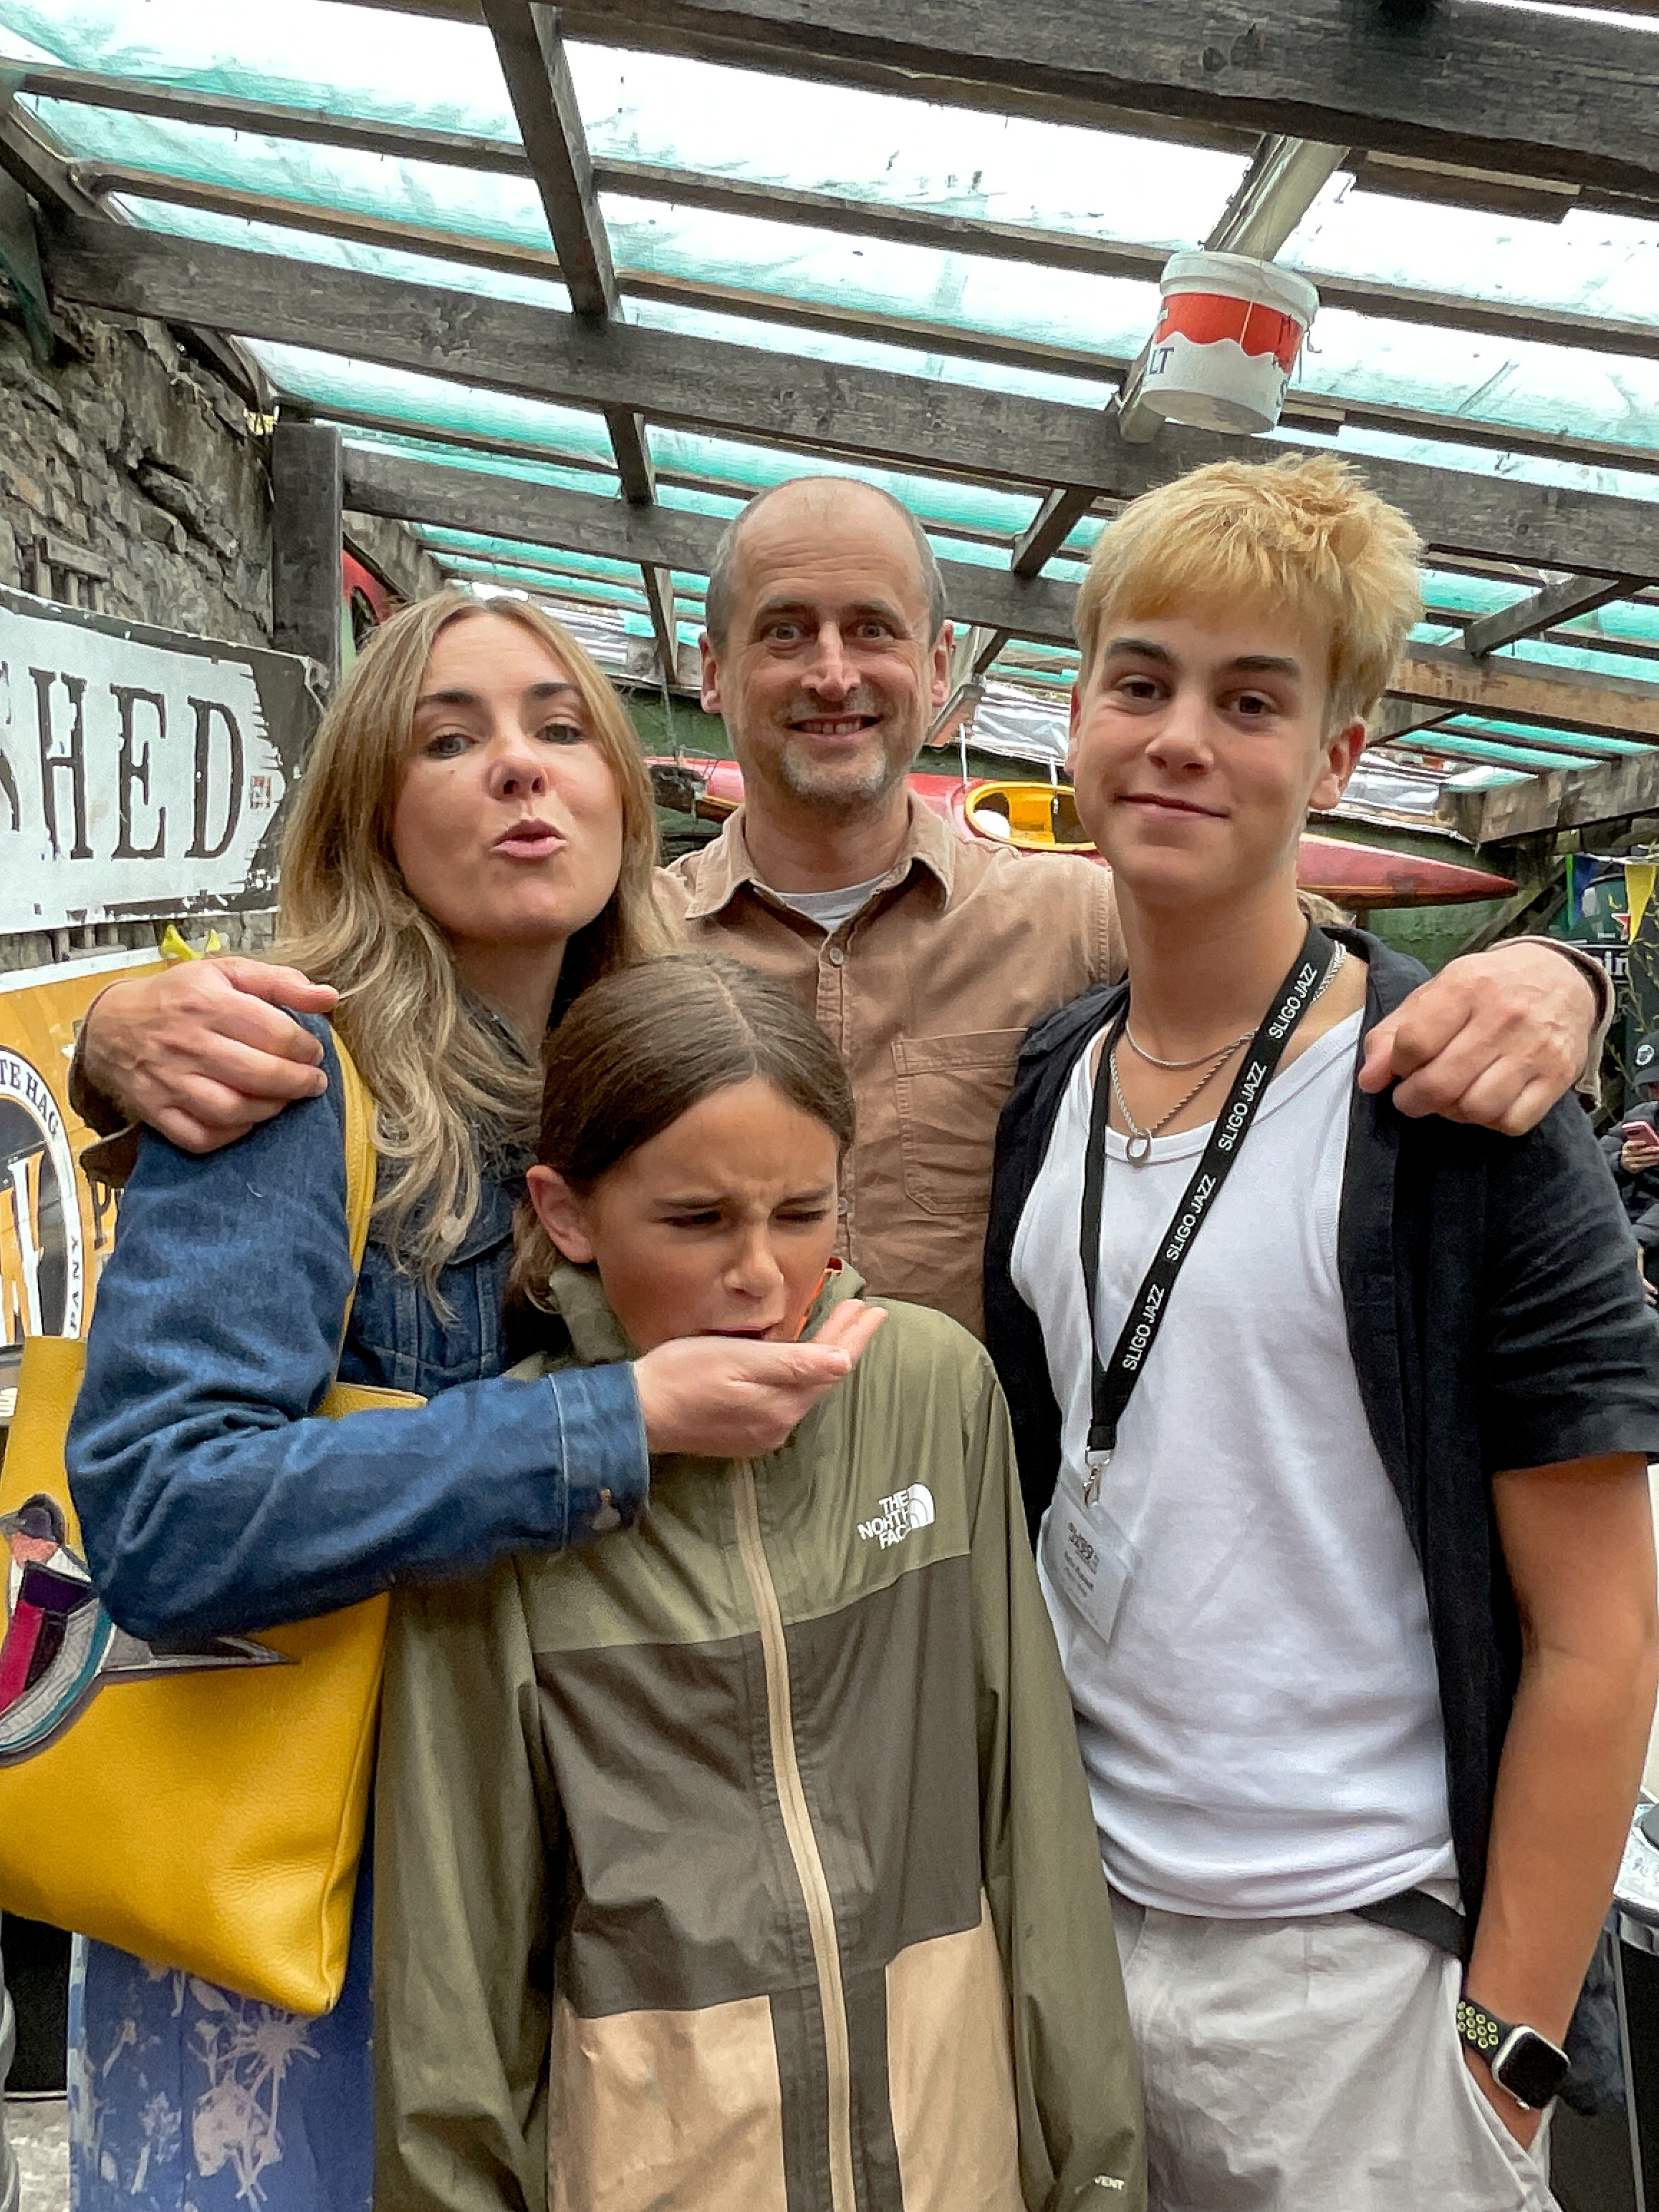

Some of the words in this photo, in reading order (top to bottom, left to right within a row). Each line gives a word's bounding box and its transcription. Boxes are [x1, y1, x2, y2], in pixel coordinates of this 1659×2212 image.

[1268, 996, 1301, 1039] SLIGO
[1294, 963, 1318, 999] JAZZ
[27, 1072, 59, 1138] HAG
[1218, 1102, 1249, 1152] SLIGO
[1241, 1061, 1268, 1102] JAZZ
[1166, 1213, 1196, 1261] SLIGO
[1191, 1174, 1217, 1213] JAZZ
[1122, 1324, 1150, 1371] SLIGO
[1142, 1284, 1165, 1324] JAZZ
[878, 1489, 909, 1516] THE
[879, 1525, 912, 1550] FAC
